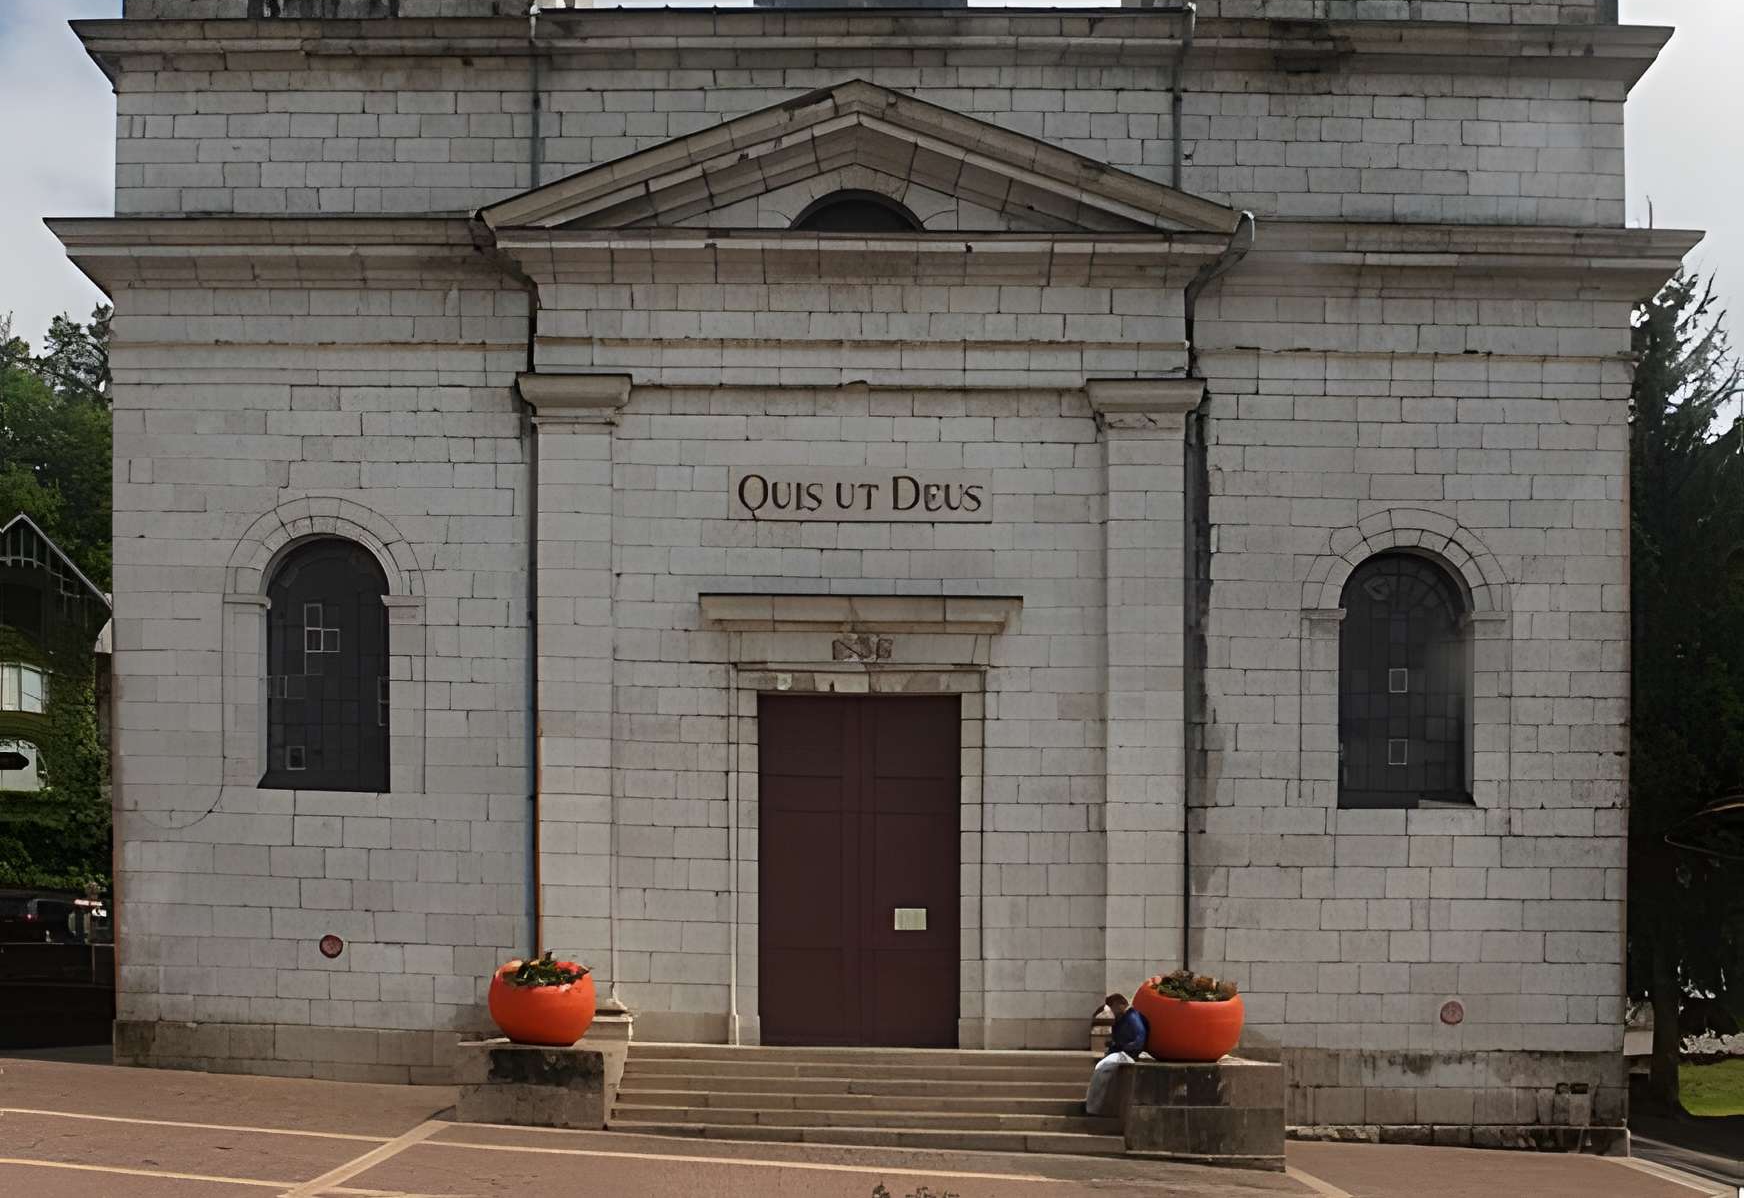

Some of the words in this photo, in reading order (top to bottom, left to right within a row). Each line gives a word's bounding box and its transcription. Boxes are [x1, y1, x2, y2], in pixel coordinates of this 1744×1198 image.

[738, 473, 824, 522] QUIS
[835, 482, 880, 511] UT
[892, 475, 985, 513] DEUS
